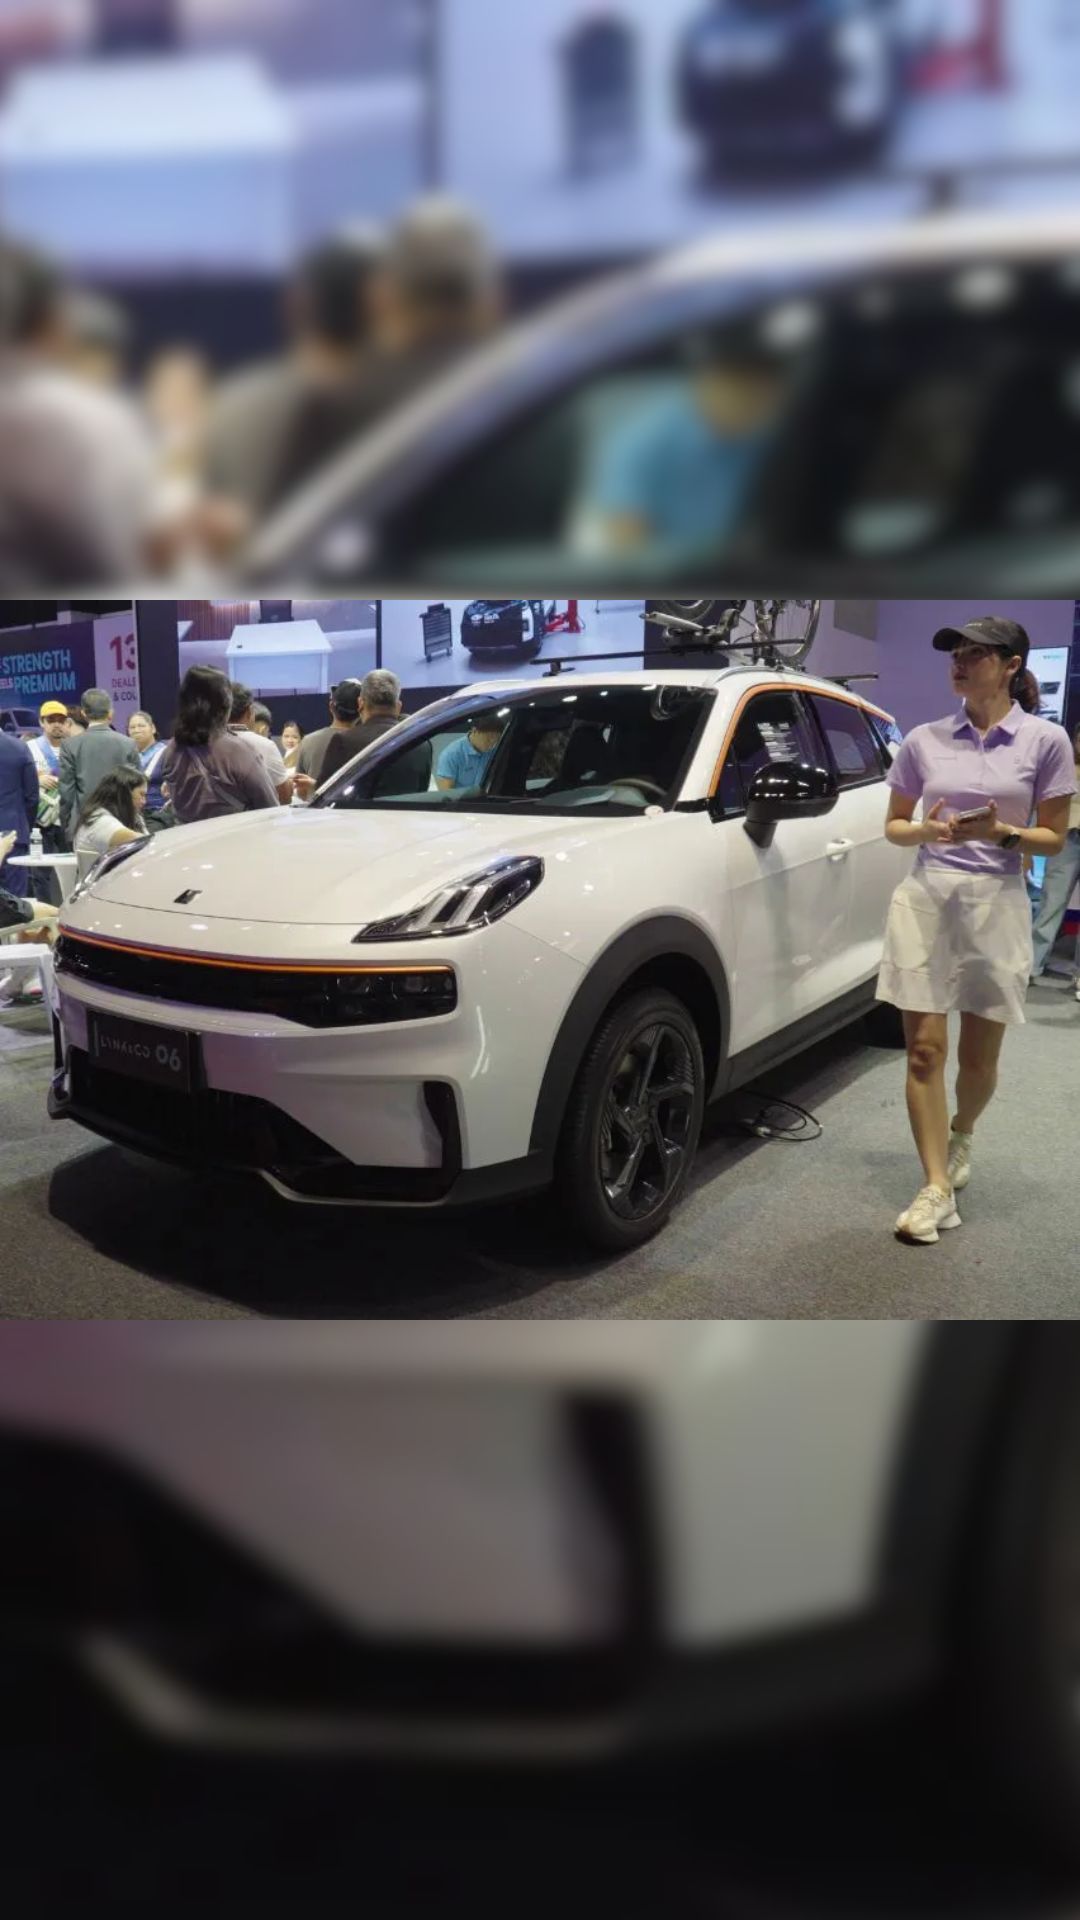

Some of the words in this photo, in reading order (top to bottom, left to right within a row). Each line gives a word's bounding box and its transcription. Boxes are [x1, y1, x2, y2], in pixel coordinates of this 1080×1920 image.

[2, 649, 71, 674] STRENGTH
[14, 671, 76, 694] PREMIUM
[156, 1044, 181, 1072] 06
